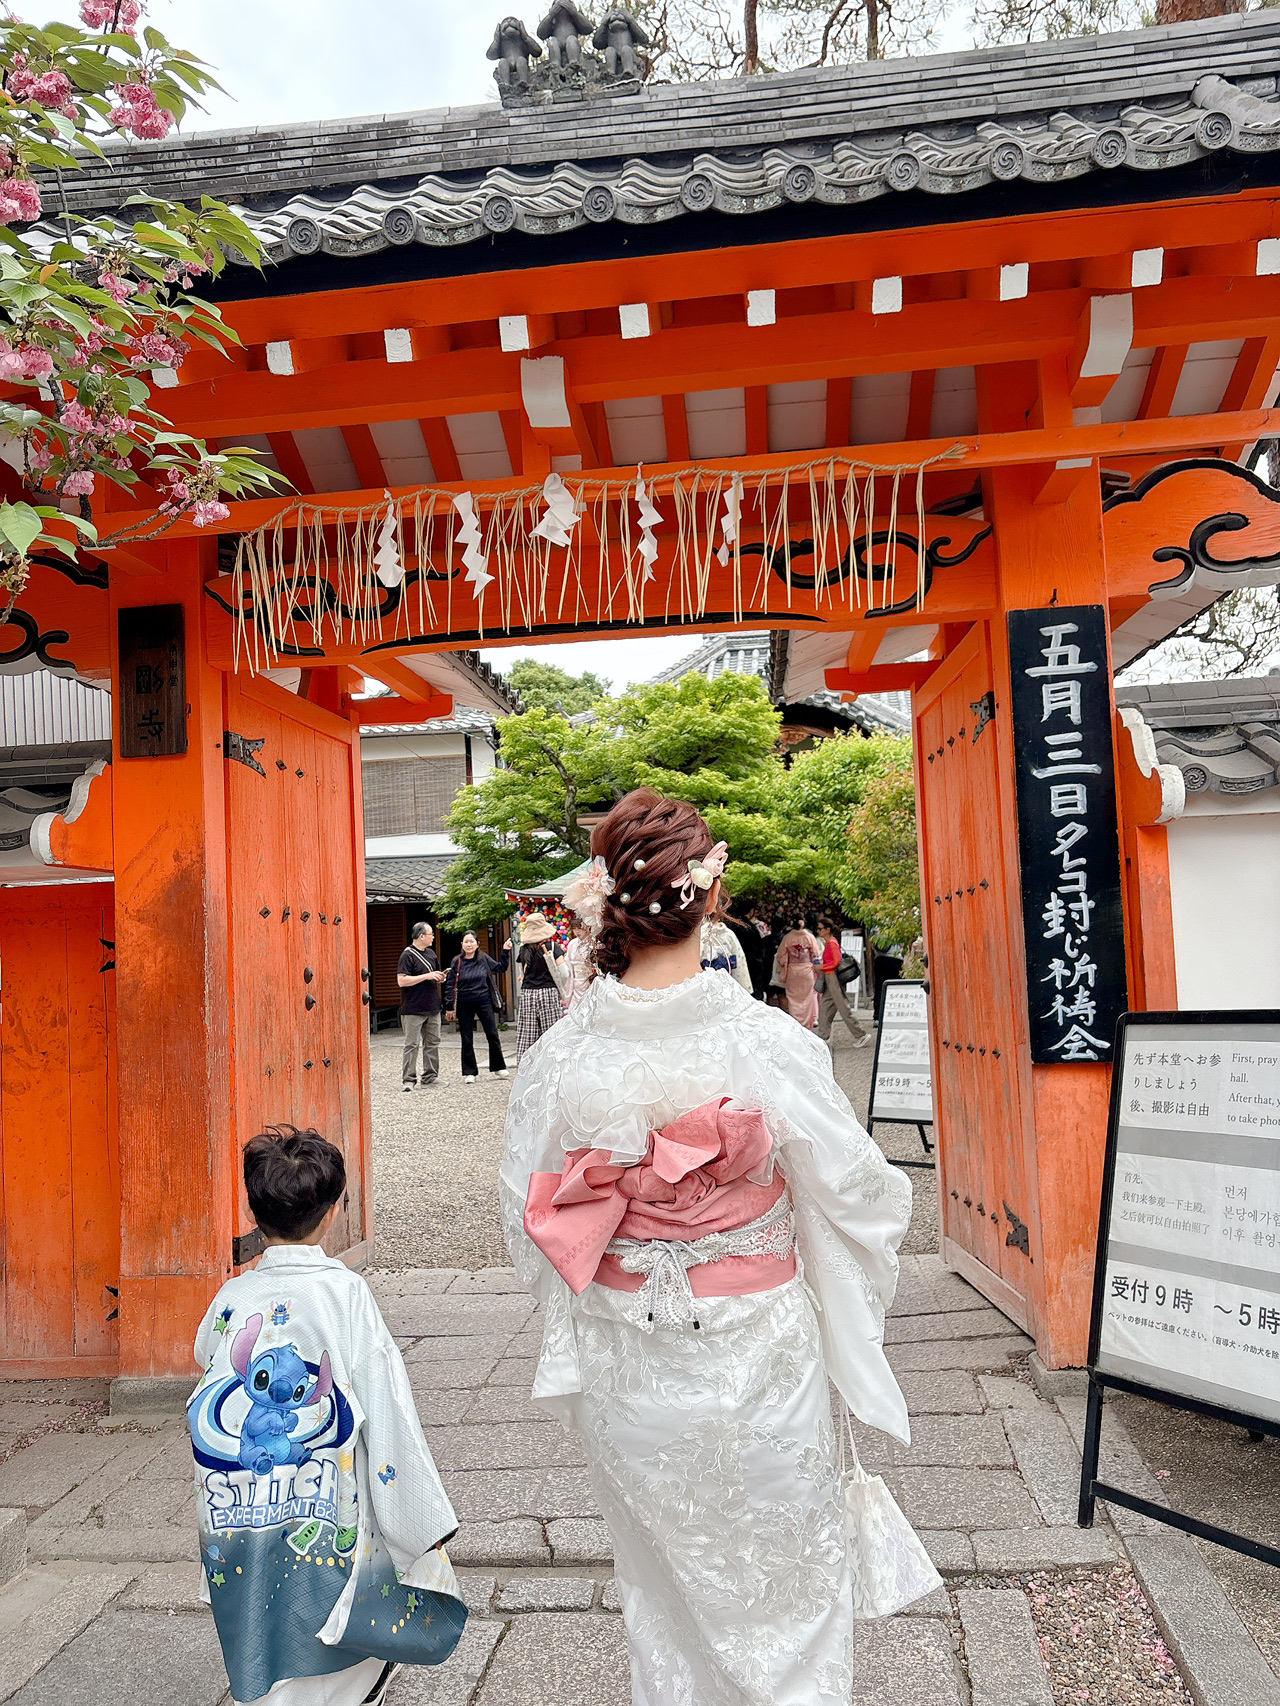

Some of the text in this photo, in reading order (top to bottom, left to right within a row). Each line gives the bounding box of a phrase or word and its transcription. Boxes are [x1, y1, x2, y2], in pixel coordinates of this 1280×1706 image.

[1133, 1052, 1221, 1067] 先ず本堂へお参
[1232, 1053, 1278, 1066] First, pray
[1134, 1076, 1197, 1091] りしましょう
[1230, 1072, 1249, 1083] hall.
[1228, 1092, 1252, 1104] After
[1253, 1093, 1275, 1106] that,
[1130, 1099, 1209, 1117] 後、撮影は自由
[1227, 1114, 1236, 1122] to
[1238, 1113, 1258, 1124] take
[1224, 1185, 1247, 1201] 먼저
[1222, 1226, 1280, 1248] 이후 촬영
[1111, 1275, 1194, 1314] 受付9時
[206, 1459, 339, 1509] STITCH
